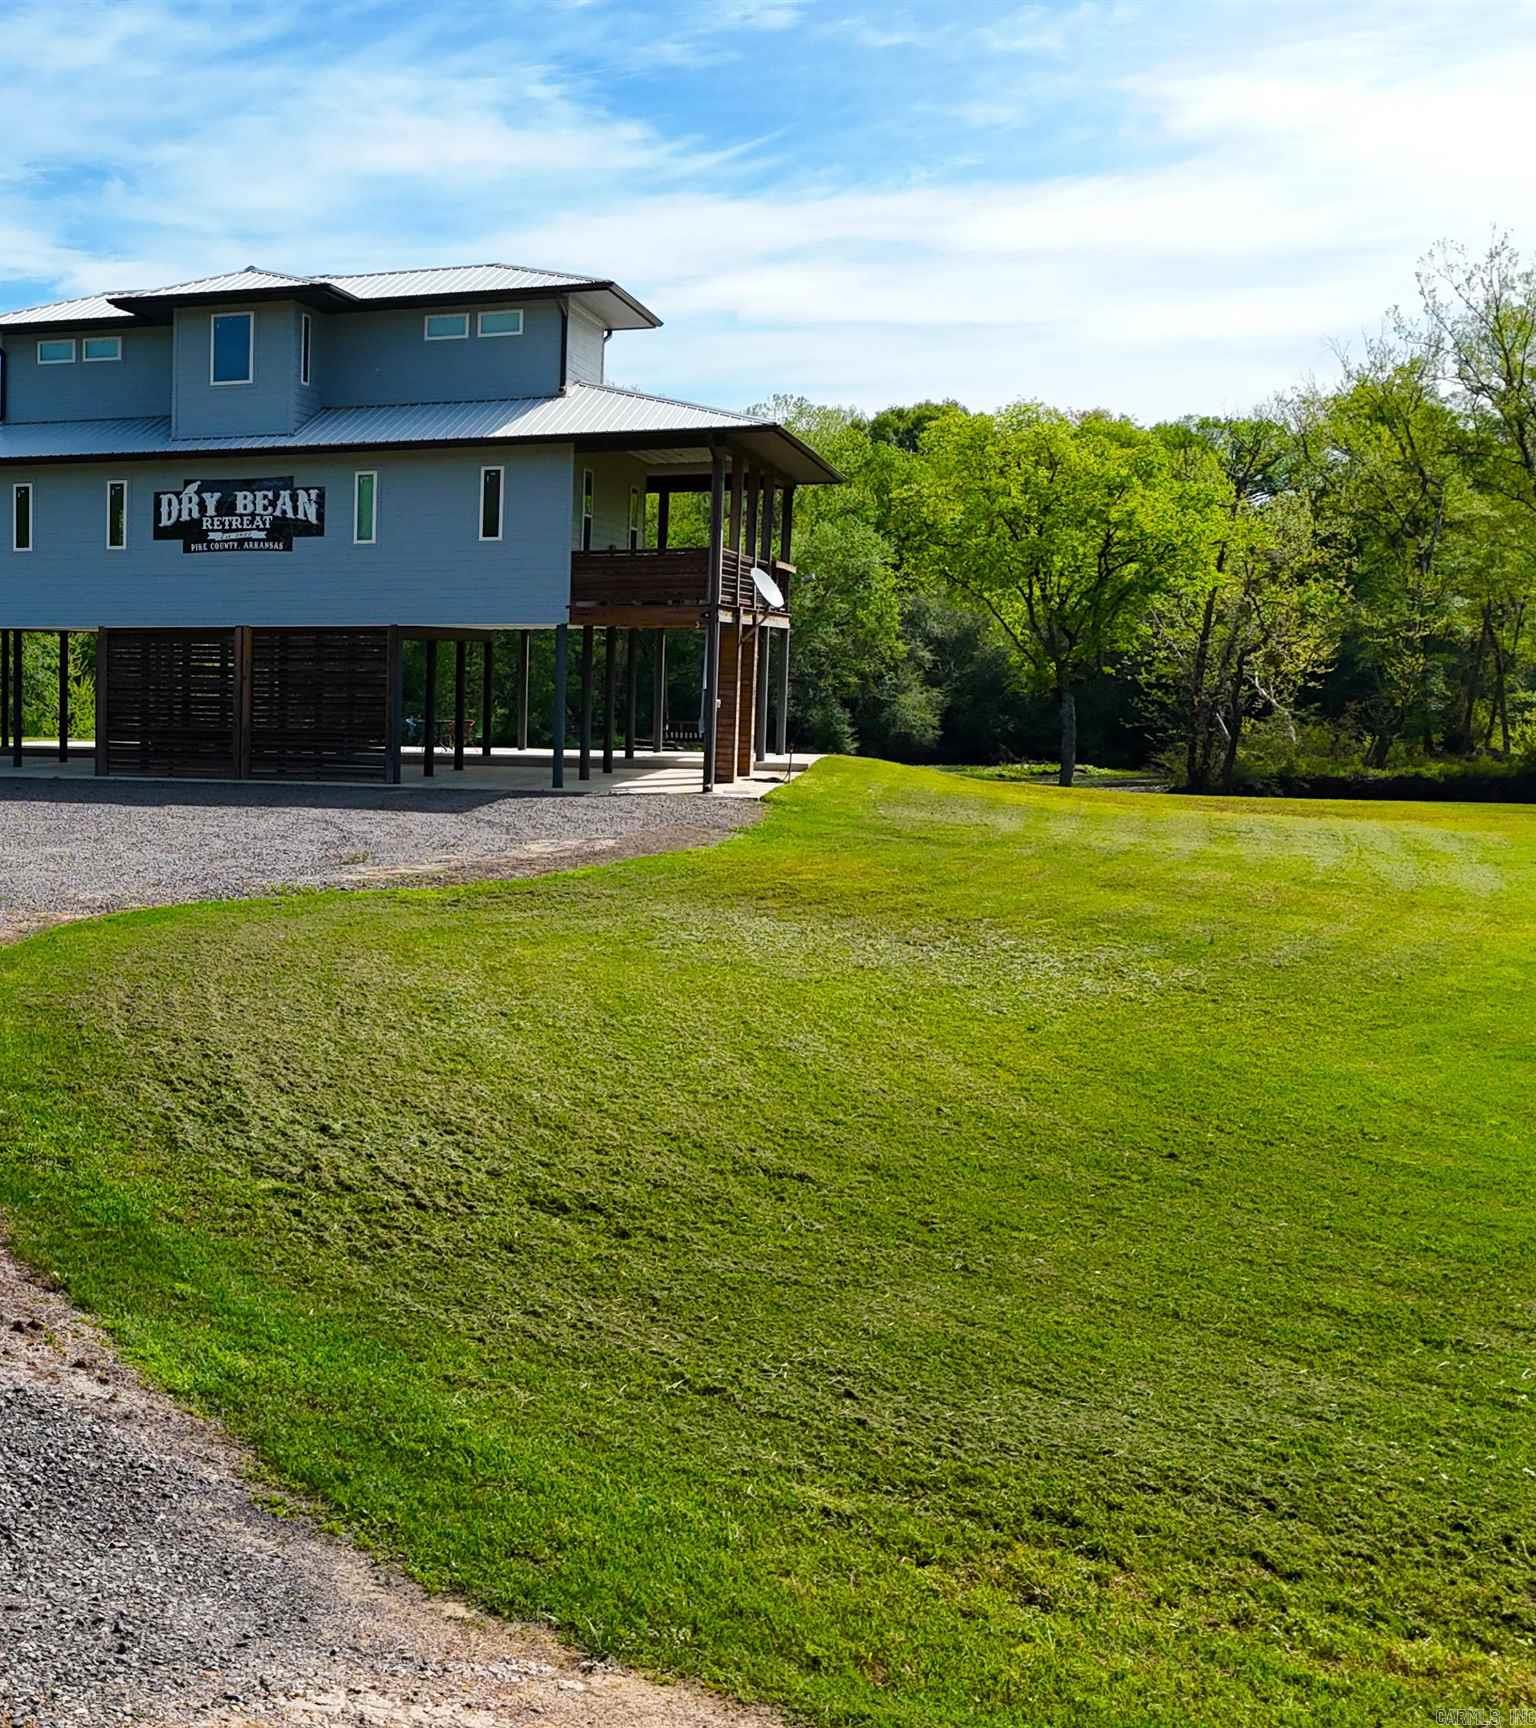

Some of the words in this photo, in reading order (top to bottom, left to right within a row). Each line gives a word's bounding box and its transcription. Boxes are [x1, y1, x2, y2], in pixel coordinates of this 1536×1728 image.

[158, 491, 222, 527] DRY
[234, 489, 319, 525] BEAN
[202, 515, 272, 530] RETREAT
[244, 541, 283, 550] ARKANSAS
